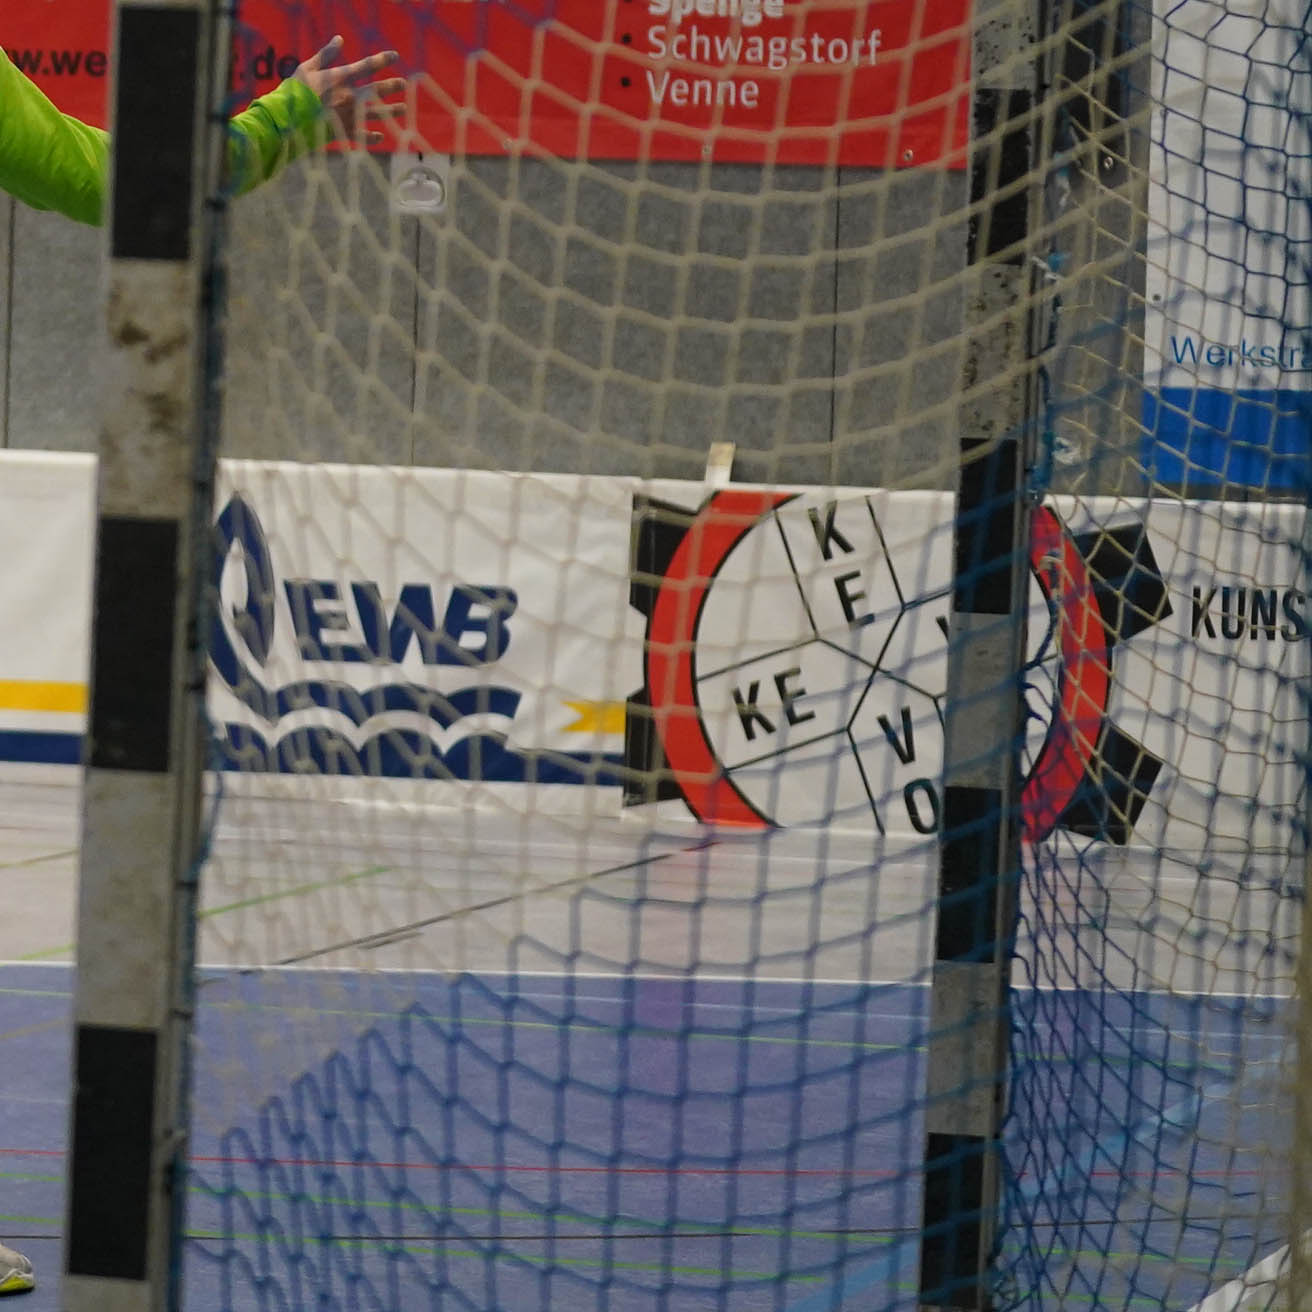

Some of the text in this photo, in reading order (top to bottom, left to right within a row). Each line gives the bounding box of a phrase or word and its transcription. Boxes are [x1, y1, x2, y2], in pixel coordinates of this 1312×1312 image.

[646, 26, 882, 71] Schwagstorf
[647, 72, 760, 110] Venne
[283, 579, 519, 666] EWB
